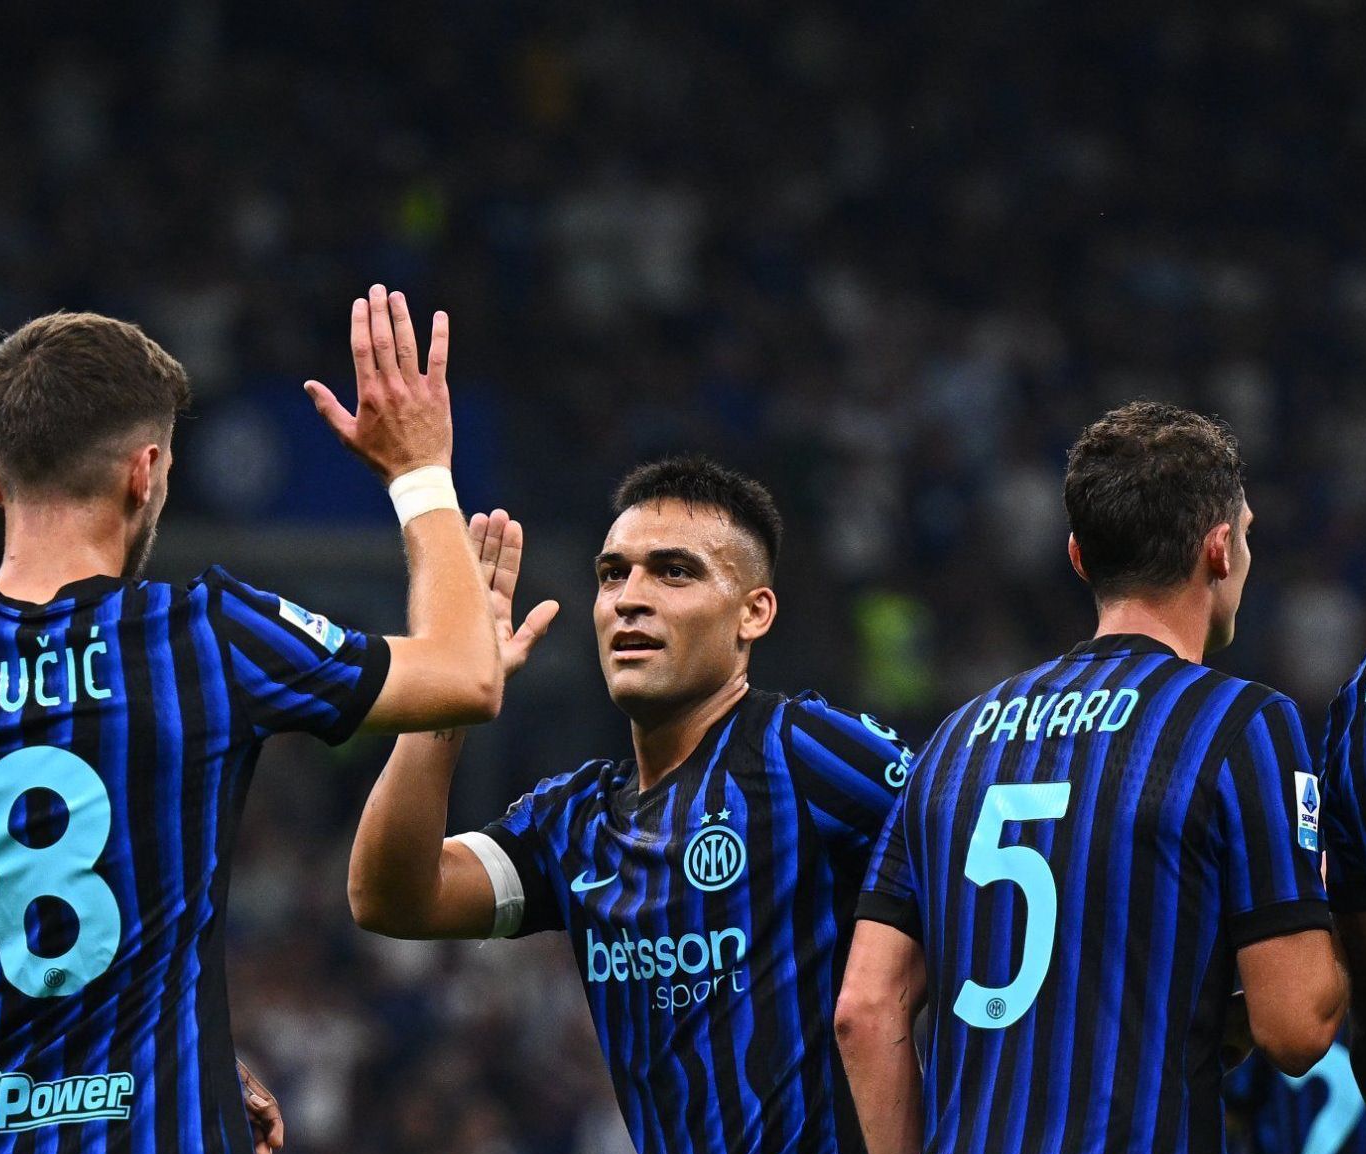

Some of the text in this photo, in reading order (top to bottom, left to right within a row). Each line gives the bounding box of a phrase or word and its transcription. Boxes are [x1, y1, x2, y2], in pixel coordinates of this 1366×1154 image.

[966, 688, 1139, 748] PAVARD
[953, 782, 1071, 1029] 5
[587, 927, 746, 983] betsson
[651, 970, 745, 1015] .sport
